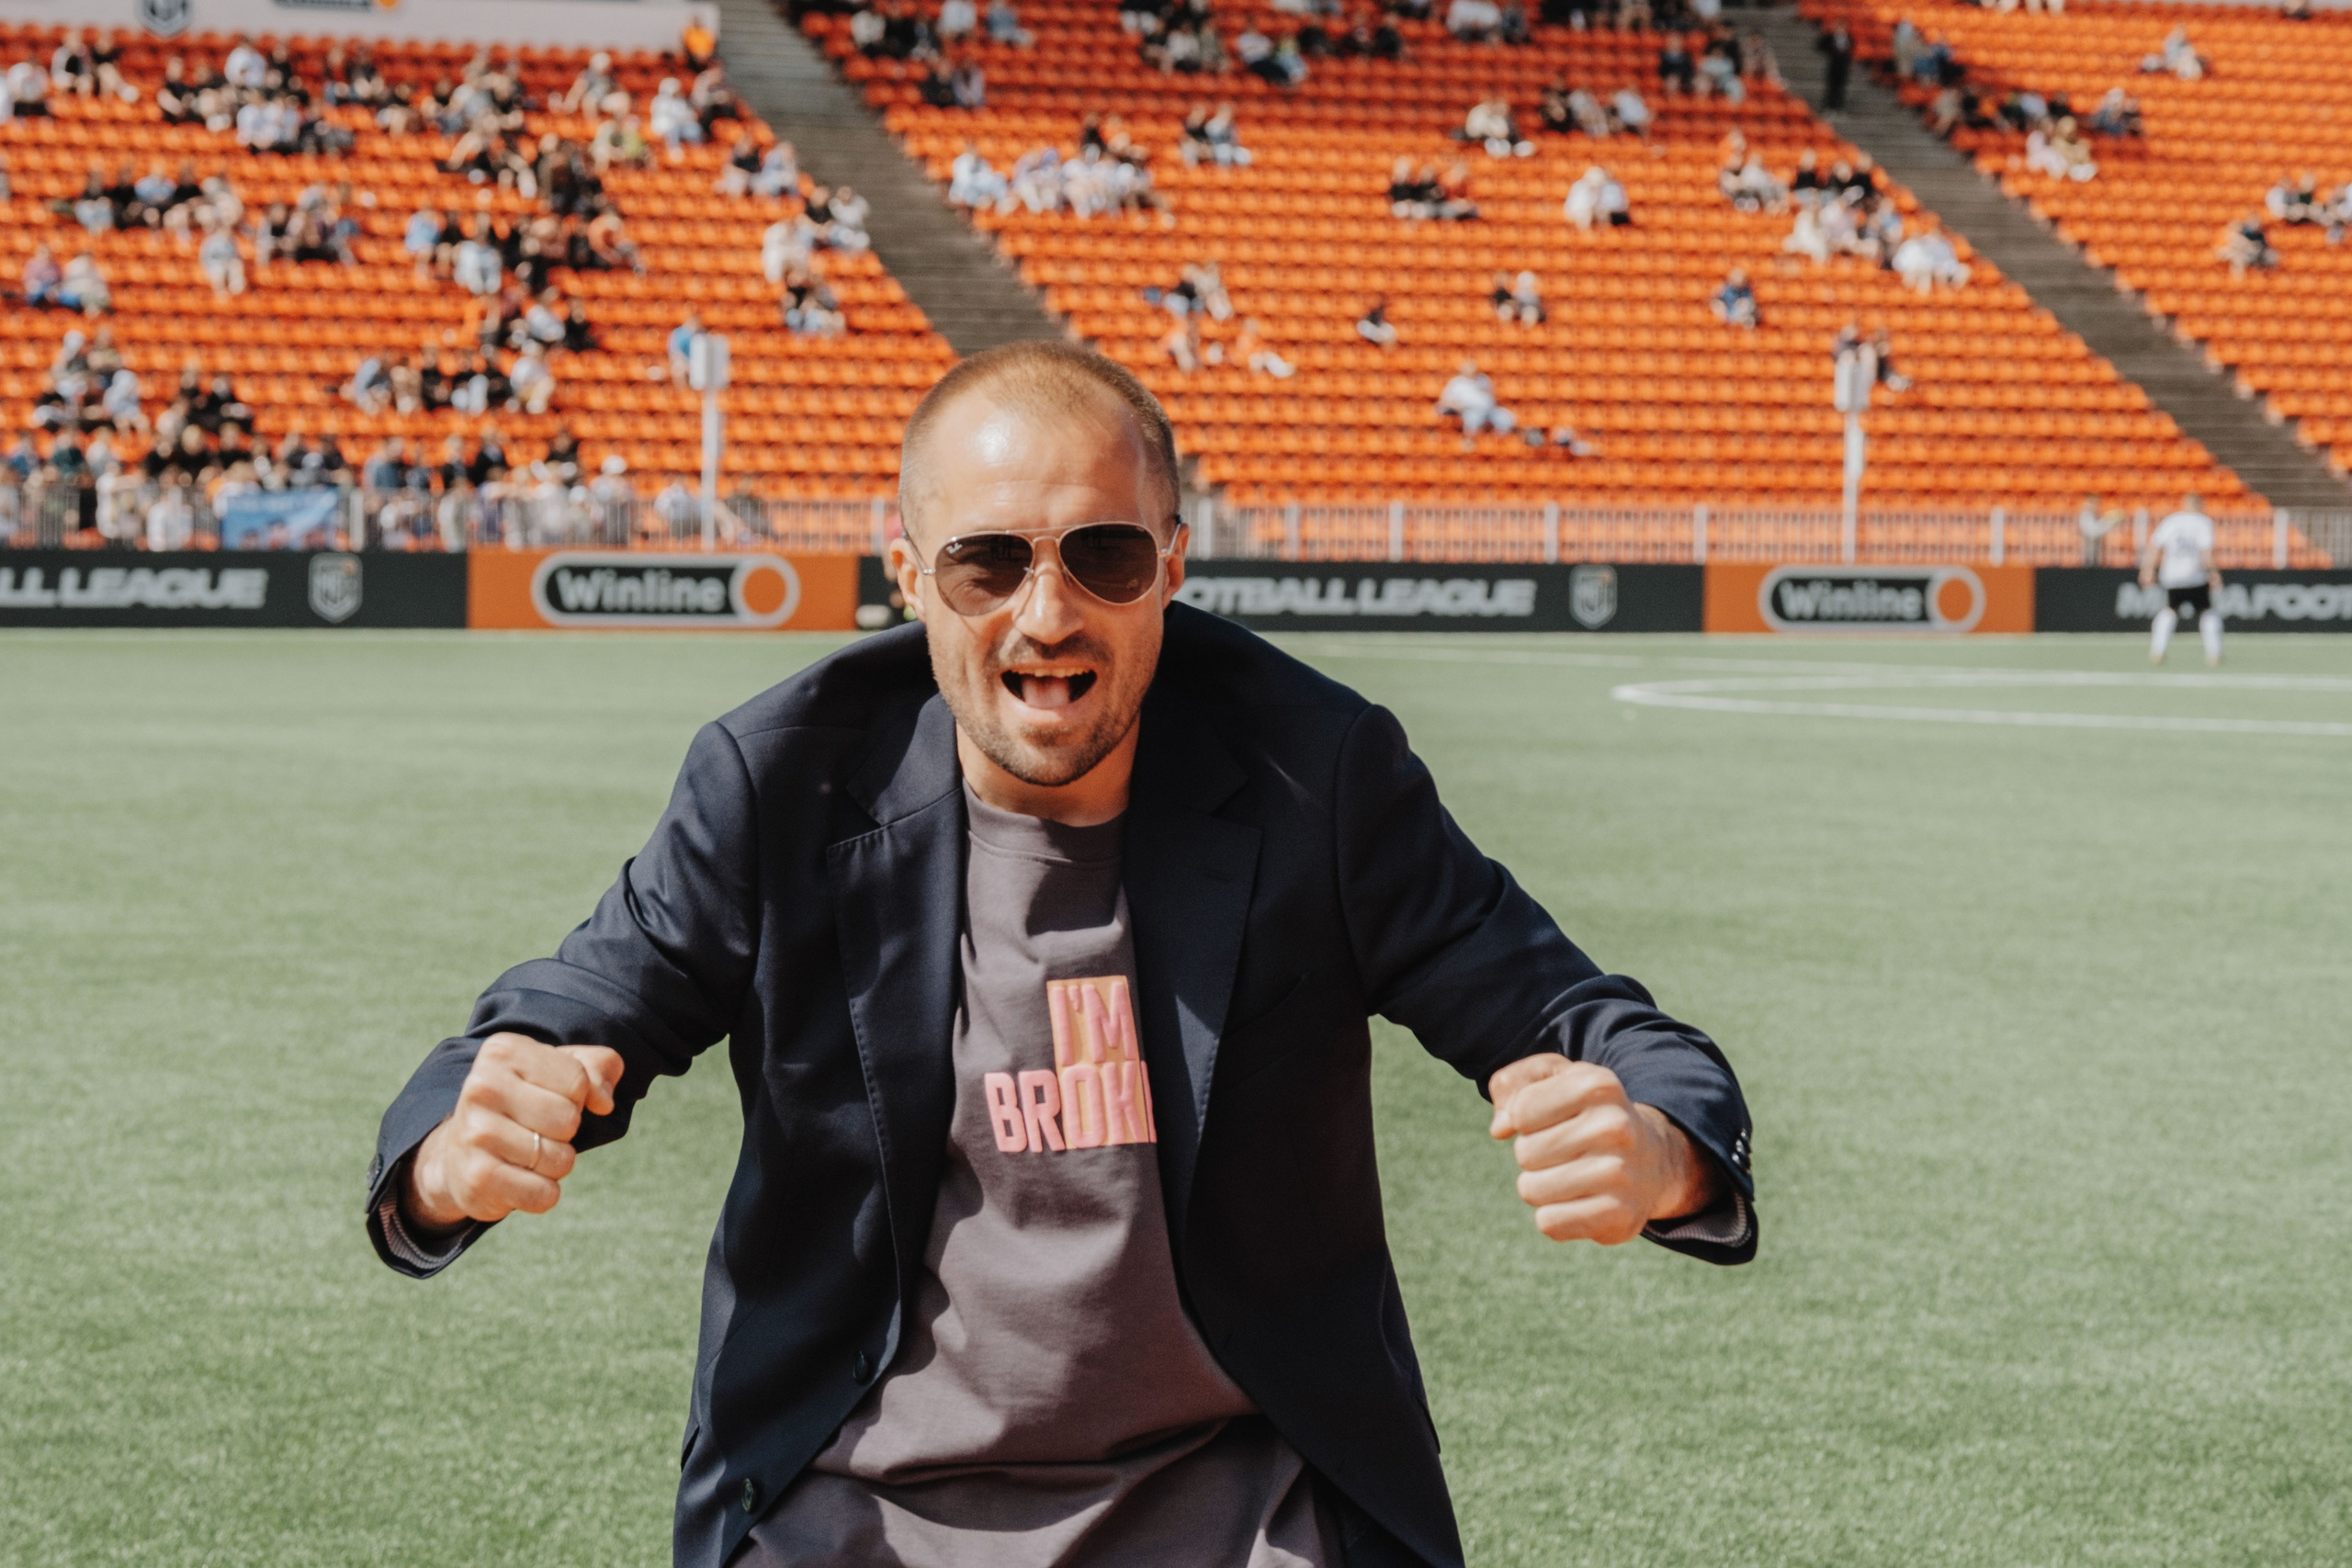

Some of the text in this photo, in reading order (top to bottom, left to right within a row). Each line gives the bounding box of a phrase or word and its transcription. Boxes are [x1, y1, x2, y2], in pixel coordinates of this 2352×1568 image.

[56, 567, 268, 609] LEAGUE
[555, 568, 727, 613] Winline
[1356, 577, 1538, 617] LEAGUE
[1778, 580, 1923, 621] Winline
[1050, 981, 1136, 1067] I'M
